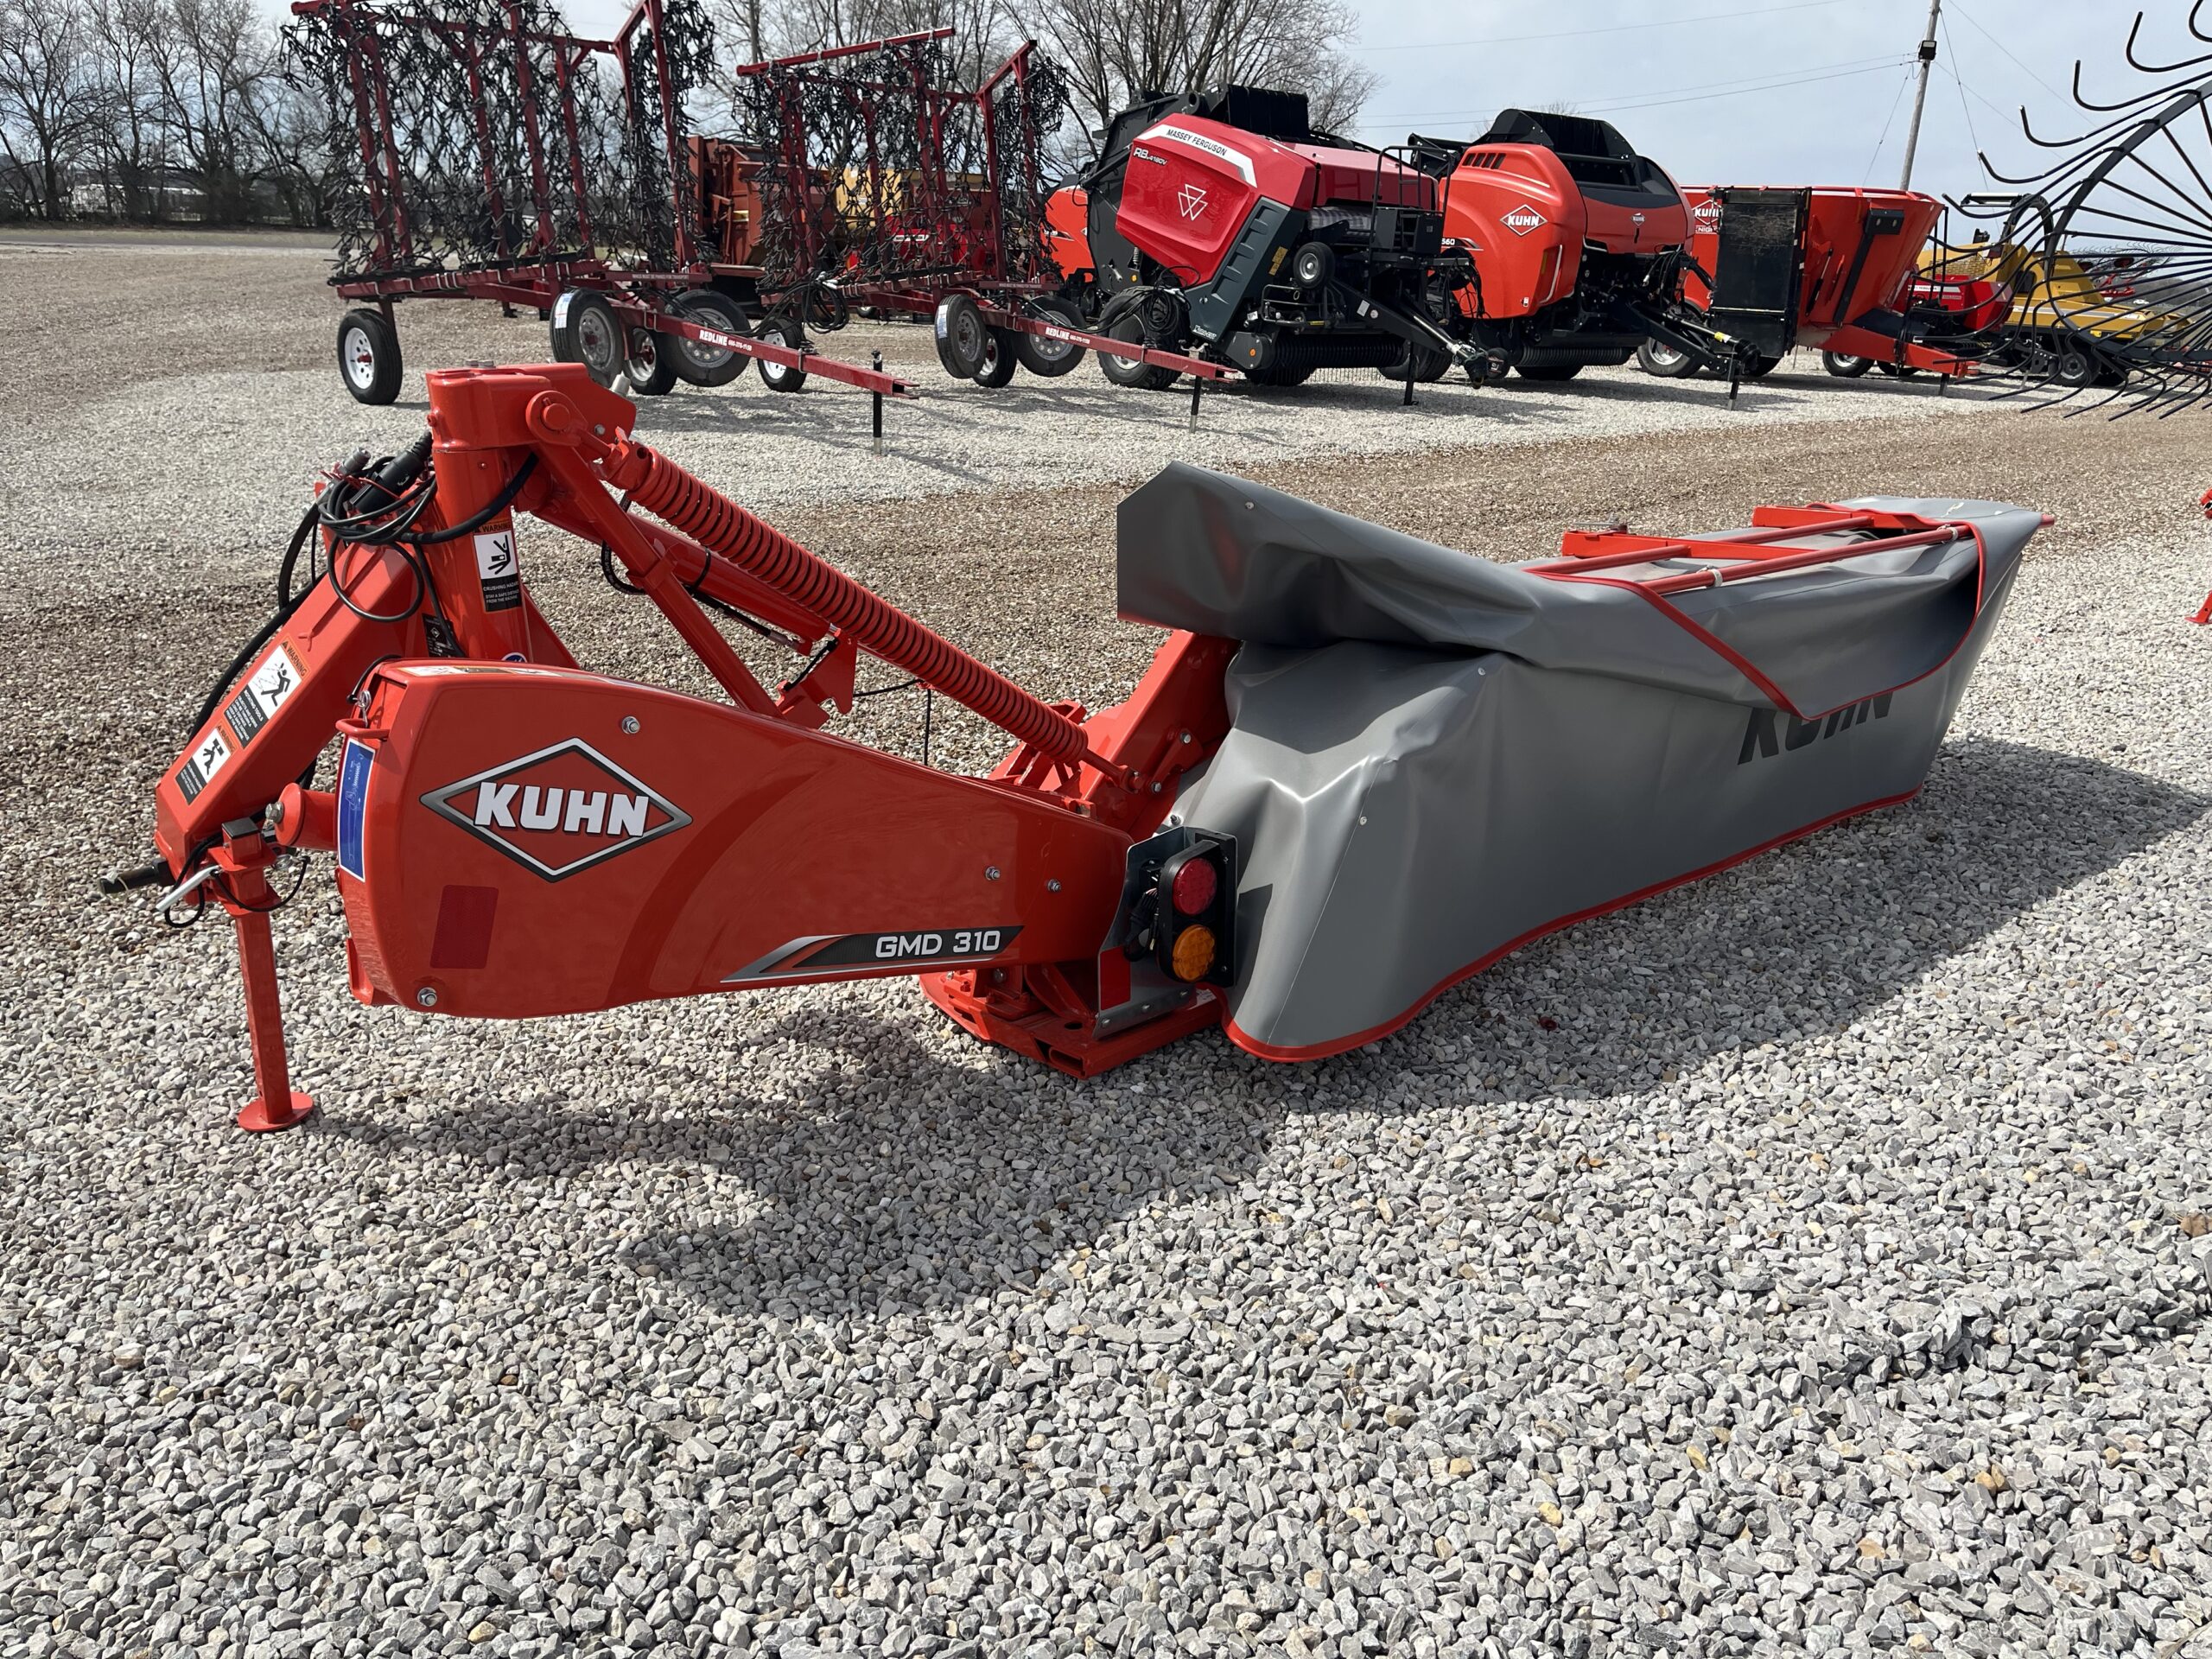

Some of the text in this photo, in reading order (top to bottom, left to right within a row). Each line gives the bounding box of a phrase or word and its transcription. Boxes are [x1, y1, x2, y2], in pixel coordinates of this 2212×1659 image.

[1166, 129, 1227, 156] MASSEY FERGUSON
[1507, 215, 1540, 226] KUHN
[699, 330, 728, 346] REDLINE
[1045, 327, 1070, 340] REDLINE
[287, 645, 308, 677] WARNING
[474, 781, 649, 836] KUHN
[875, 930, 1001, 958] GMD 310
